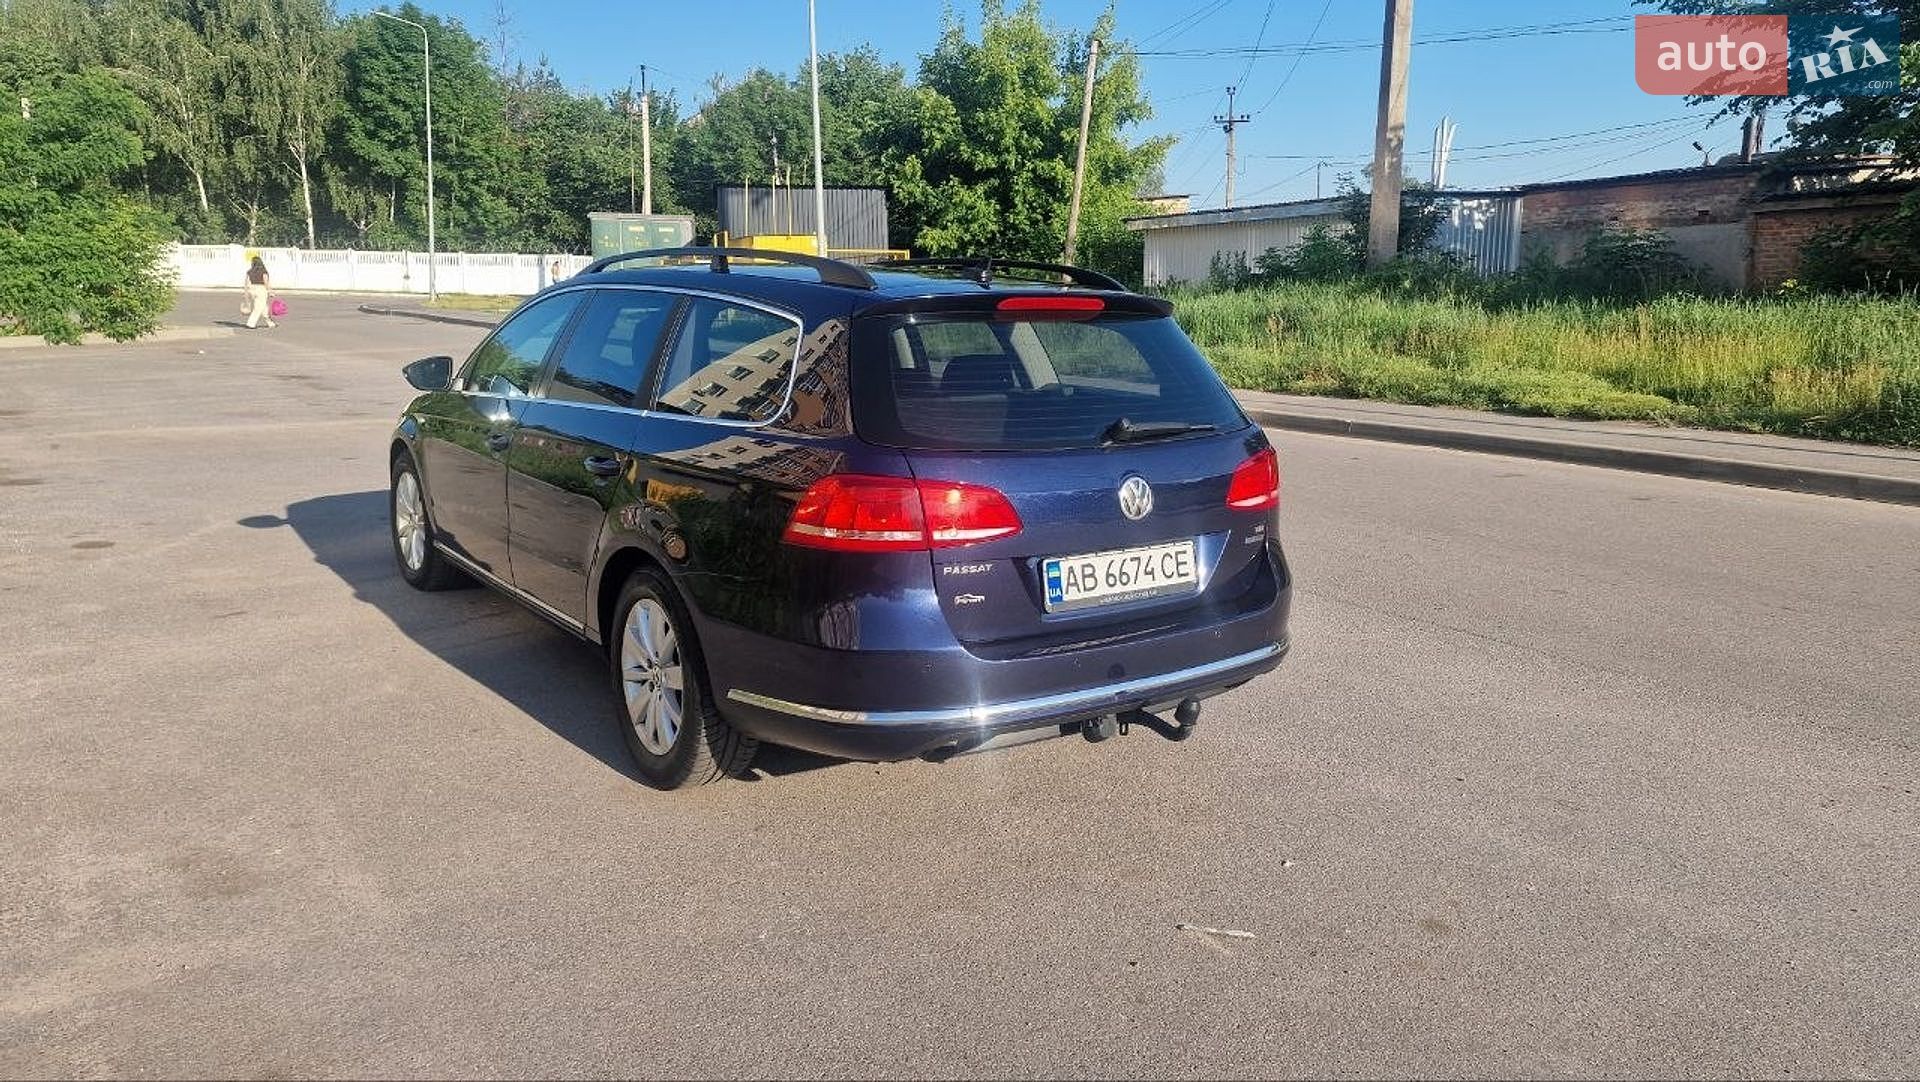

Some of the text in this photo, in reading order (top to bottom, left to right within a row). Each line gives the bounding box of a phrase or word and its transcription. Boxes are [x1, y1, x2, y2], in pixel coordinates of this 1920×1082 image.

[943, 563, 993, 575] PASSAT
[1066, 551, 1190, 594] AB 6674 CE
[1050, 588, 1062, 597] UA
